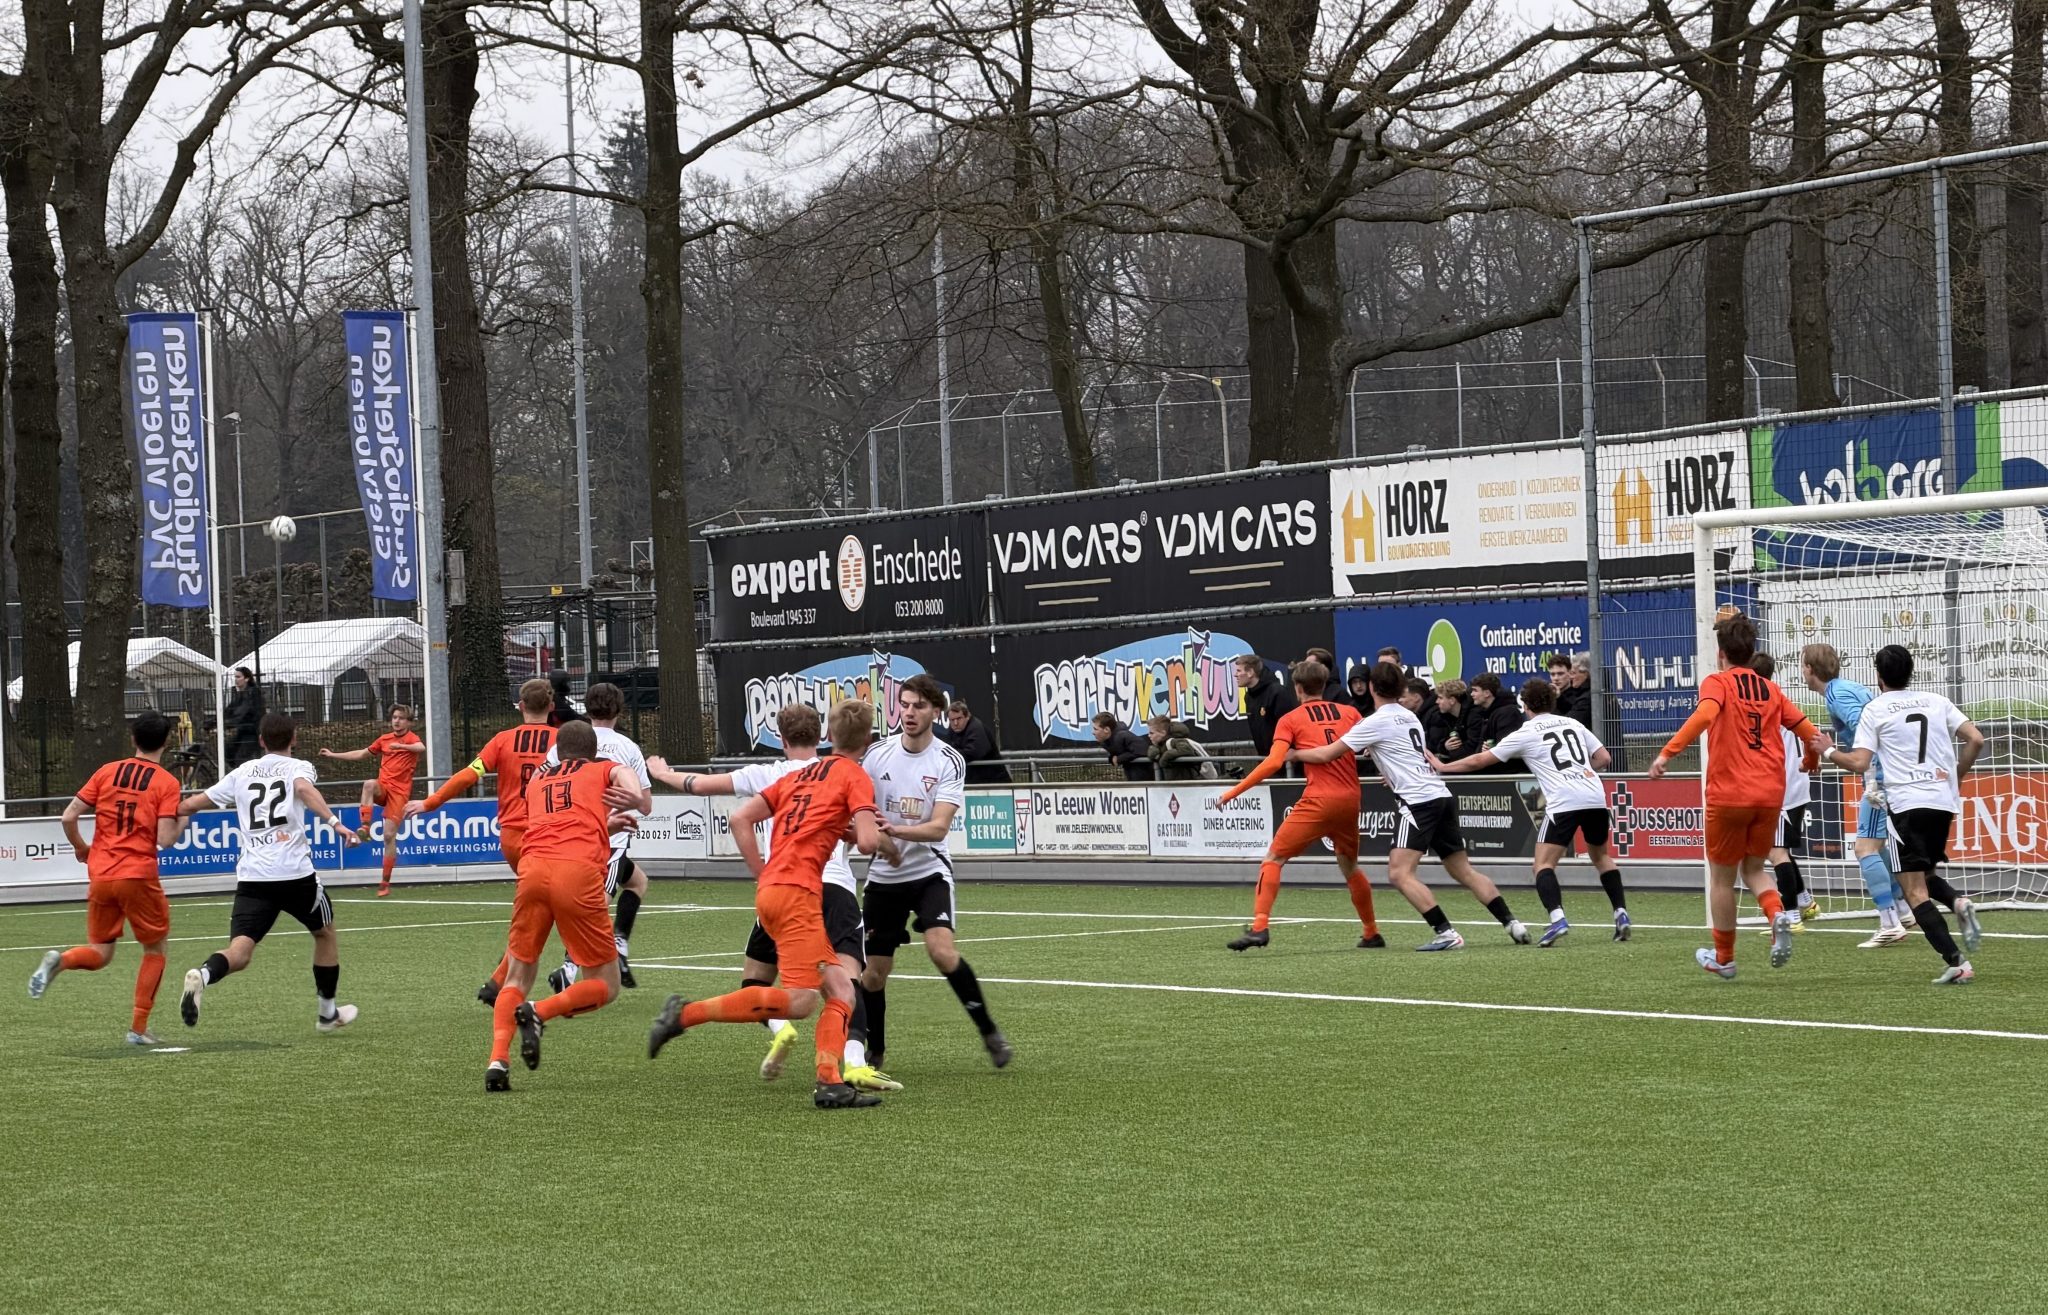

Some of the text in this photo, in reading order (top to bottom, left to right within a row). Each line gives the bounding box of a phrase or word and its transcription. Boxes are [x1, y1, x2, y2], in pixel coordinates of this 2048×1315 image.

[1665, 451, 1736, 517] HORZ
[1385, 479, 1449, 538] HORZ
[1230, 500, 1317, 552] CARS
[872, 536, 962, 586] Enschede
[731, 550, 831, 604] expert
[750, 608, 817, 629] Boulevard 1945 337
[894, 599, 944, 618] 053 200 8000
[1480, 620, 1582, 647] Container Service
[1485, 656, 1507, 675] van
[1508, 652, 1518, 673] 4
[1517, 652, 1538, 673] tot
[1748, 711, 1763, 750] 3
[1905, 713, 1928, 764] 7
[1409, 728, 1428, 763] 9
[1543, 729, 1586, 771] 20
[248, 780, 288, 830] 22
[542, 780, 572, 813] 13
[1034, 791, 1145, 815] De Leeuw Wonen
[1458, 796, 1512, 811] TENTSPECIALIST
[971, 804, 995, 820] KOOP
[1203, 818, 1265, 831] DINER CATERING
[1358, 810, 1396, 838] urgers
[1628, 807, 1703, 831] DUSSCHOT
[1952, 796, 2040, 852] ING
[652, 830, 661, 840] 02
[662, 830, 671, 840] 97
[678, 820, 701, 836] Veritas
[971, 825, 1013, 840] SERVICE
[1157, 823, 1193, 837] GASTROBAR
[1649, 835, 1691, 846] BESTRATING
[25, 843, 55, 857] DH
